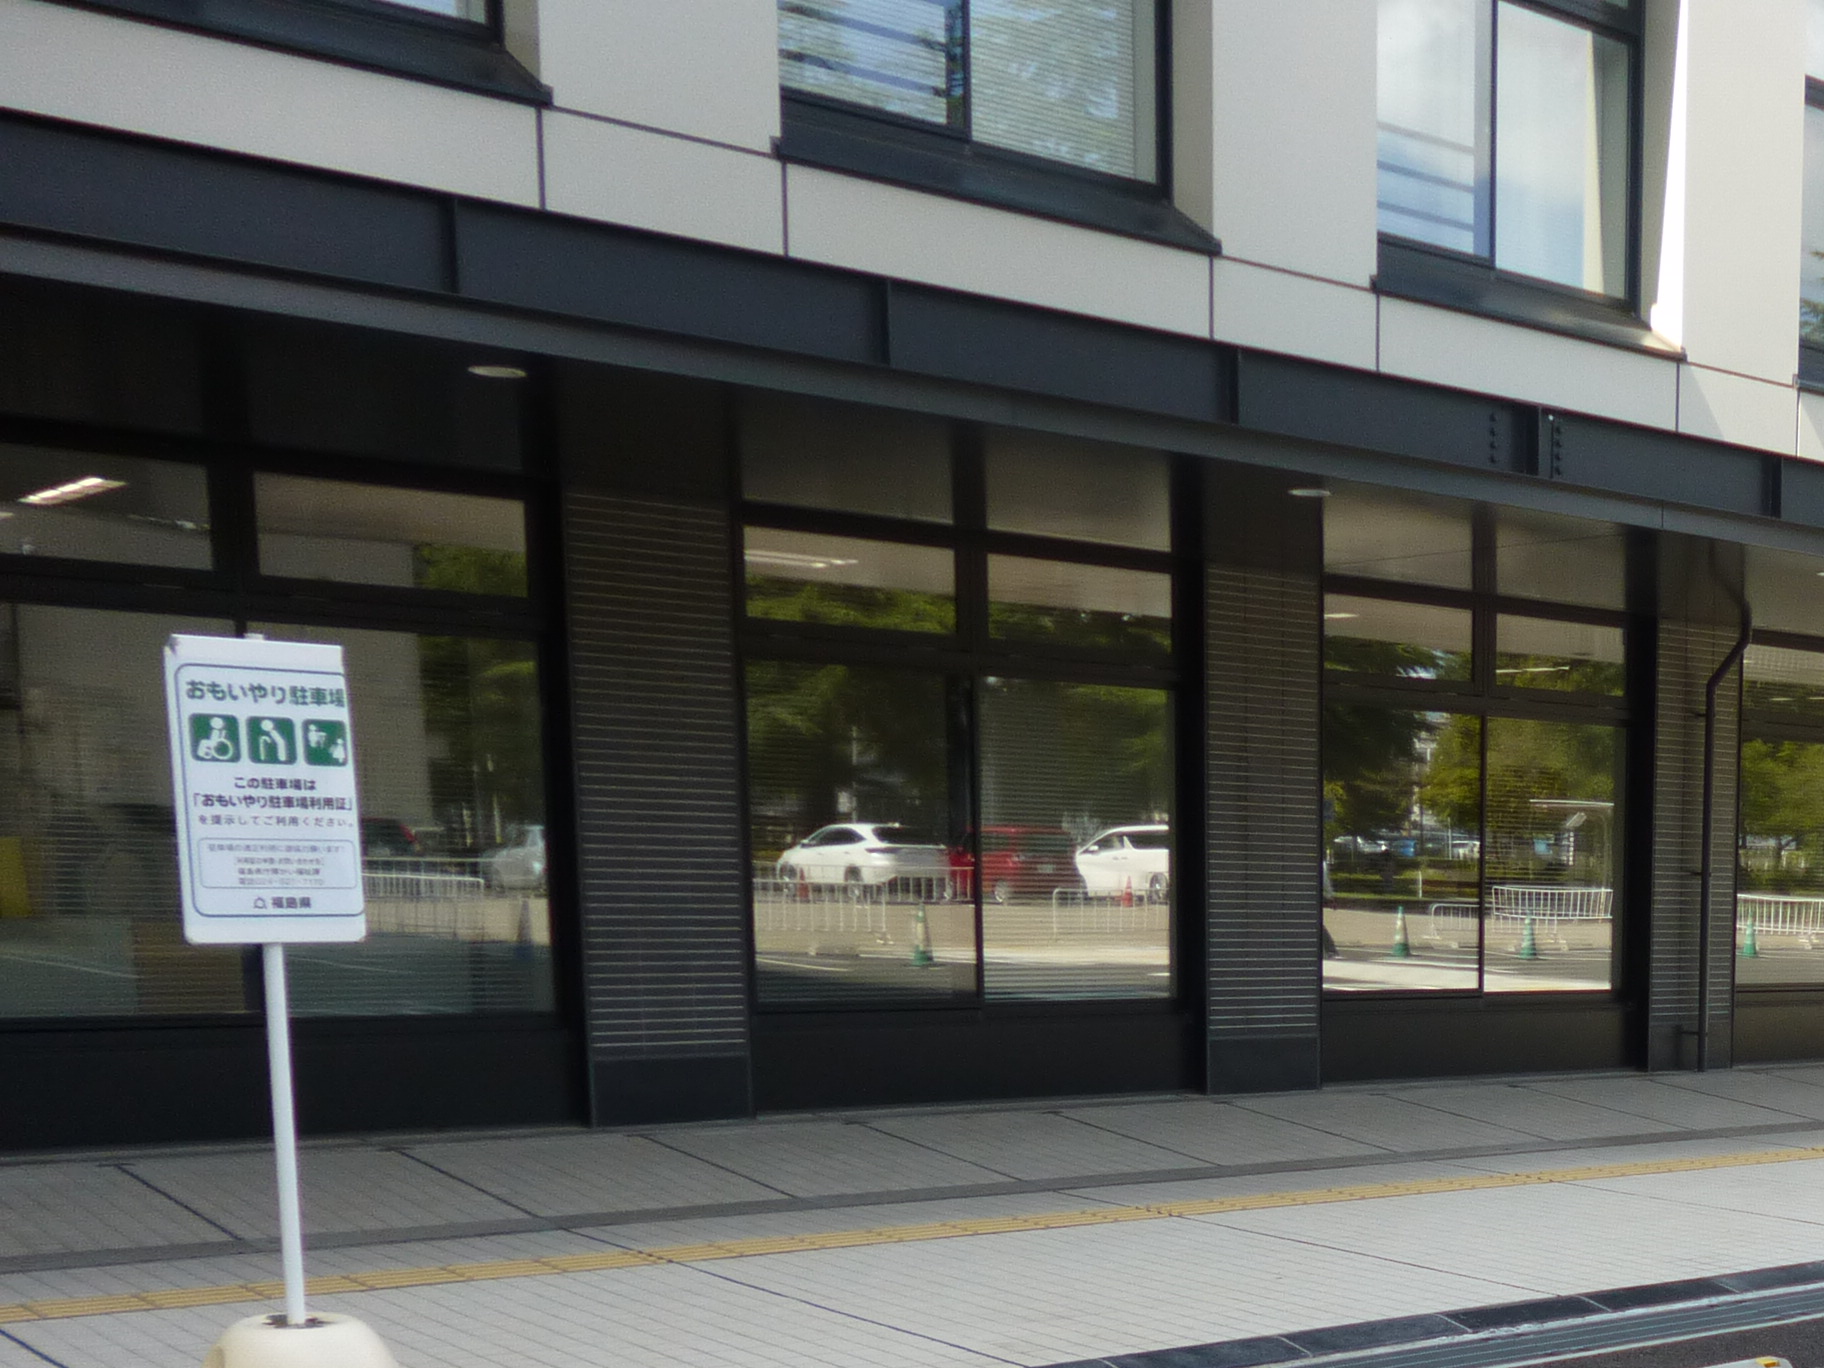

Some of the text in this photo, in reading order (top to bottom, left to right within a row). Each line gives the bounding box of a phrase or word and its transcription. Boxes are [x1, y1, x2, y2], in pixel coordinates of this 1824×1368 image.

[186, 680, 345, 707] おもいやり駐車場
[234, 777, 316, 791] この駐車場は
[193, 792, 352, 811] 「おもいやり駐車場利用証」
[271, 897, 311, 909] 福島県
